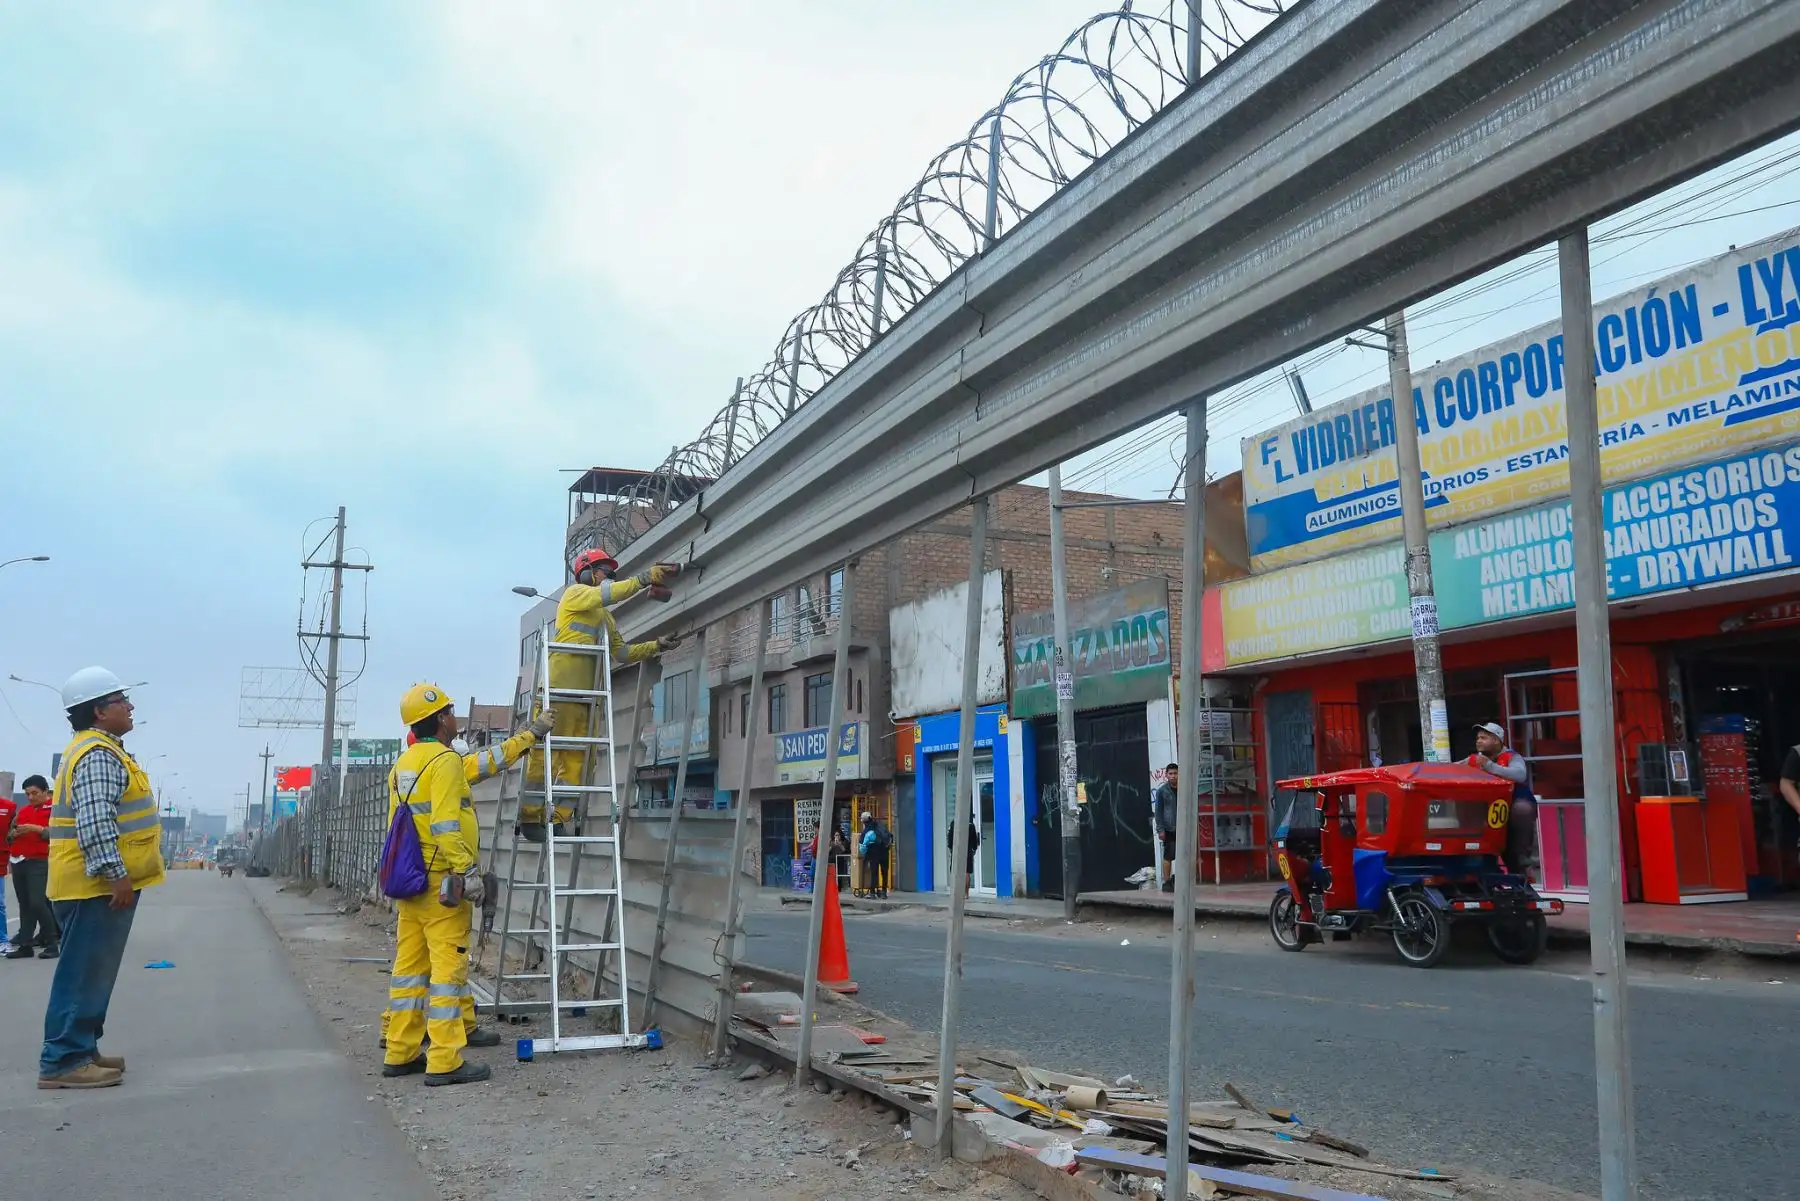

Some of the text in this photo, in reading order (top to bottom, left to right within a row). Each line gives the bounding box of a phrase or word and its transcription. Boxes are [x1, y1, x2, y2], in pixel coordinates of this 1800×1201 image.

[1291, 386, 1430, 476] VIDRIERA
[1433, 283, 1703, 430] CORPORCIÓN
[1489, 381, 1619, 452] MAYR
[1308, 493, 1398, 530] ALUMINIOS
[1423, 466, 1490, 498] IDRIOS
[1506, 422, 1645, 473] ESTANRÍA
[1612, 446, 1800, 523] ACCESORIOS
[1481, 539, 1574, 586] ANGULO
[1481, 562, 1616, 618] MELAME
[1637, 528, 1792, 589] DRYWALL
[1014, 610, 1167, 688] MAZADOS
[785, 732, 841, 759] SAN PED
[1491, 803, 1508, 825] 50
